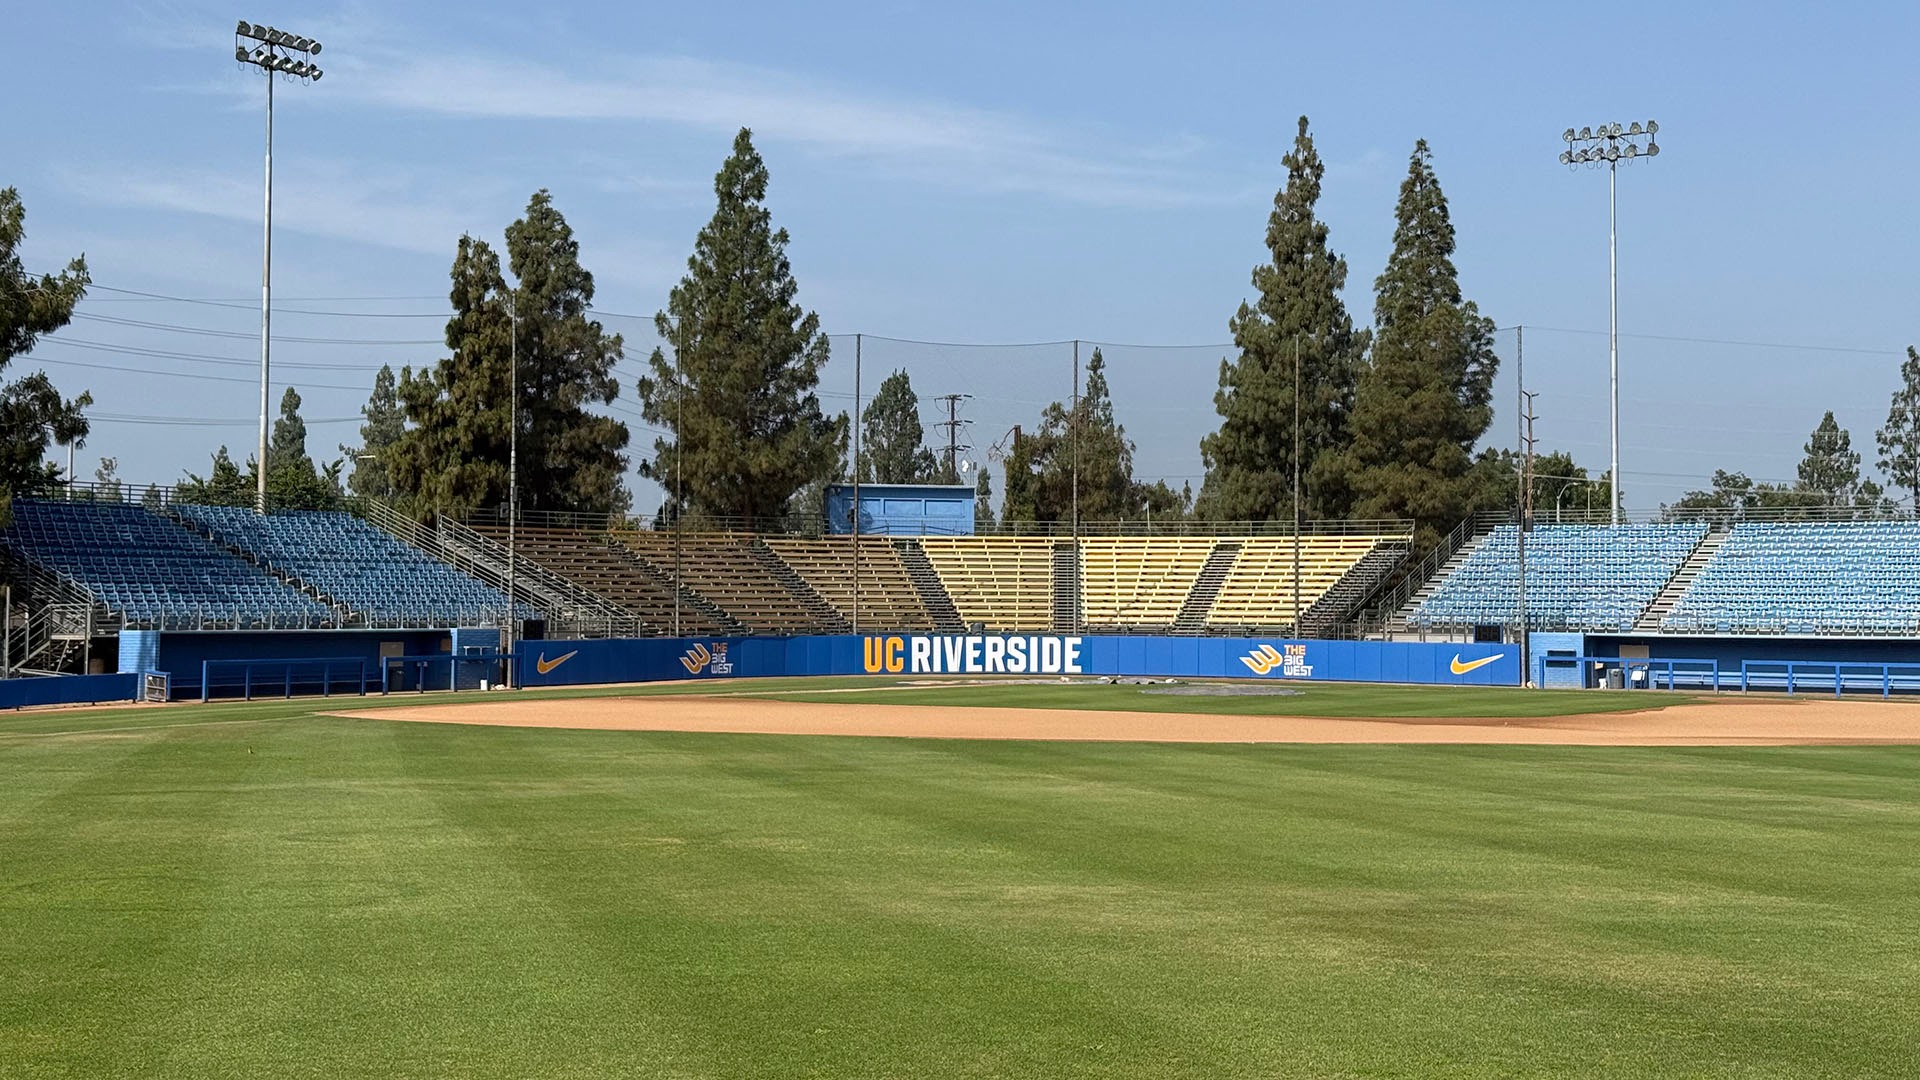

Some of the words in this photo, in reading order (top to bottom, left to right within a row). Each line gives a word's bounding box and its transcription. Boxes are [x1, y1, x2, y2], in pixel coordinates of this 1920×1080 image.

[712, 643, 728, 652] THE
[1284, 645, 1306, 655] THE
[712, 653, 726, 663] BIG
[864, 636, 904, 673] UC
[911, 636, 1082, 673] RIVERSIDE
[1284, 655, 1303, 665] BIG
[711, 664, 733, 674] WEST
[1284, 665, 1313, 676] WEST
